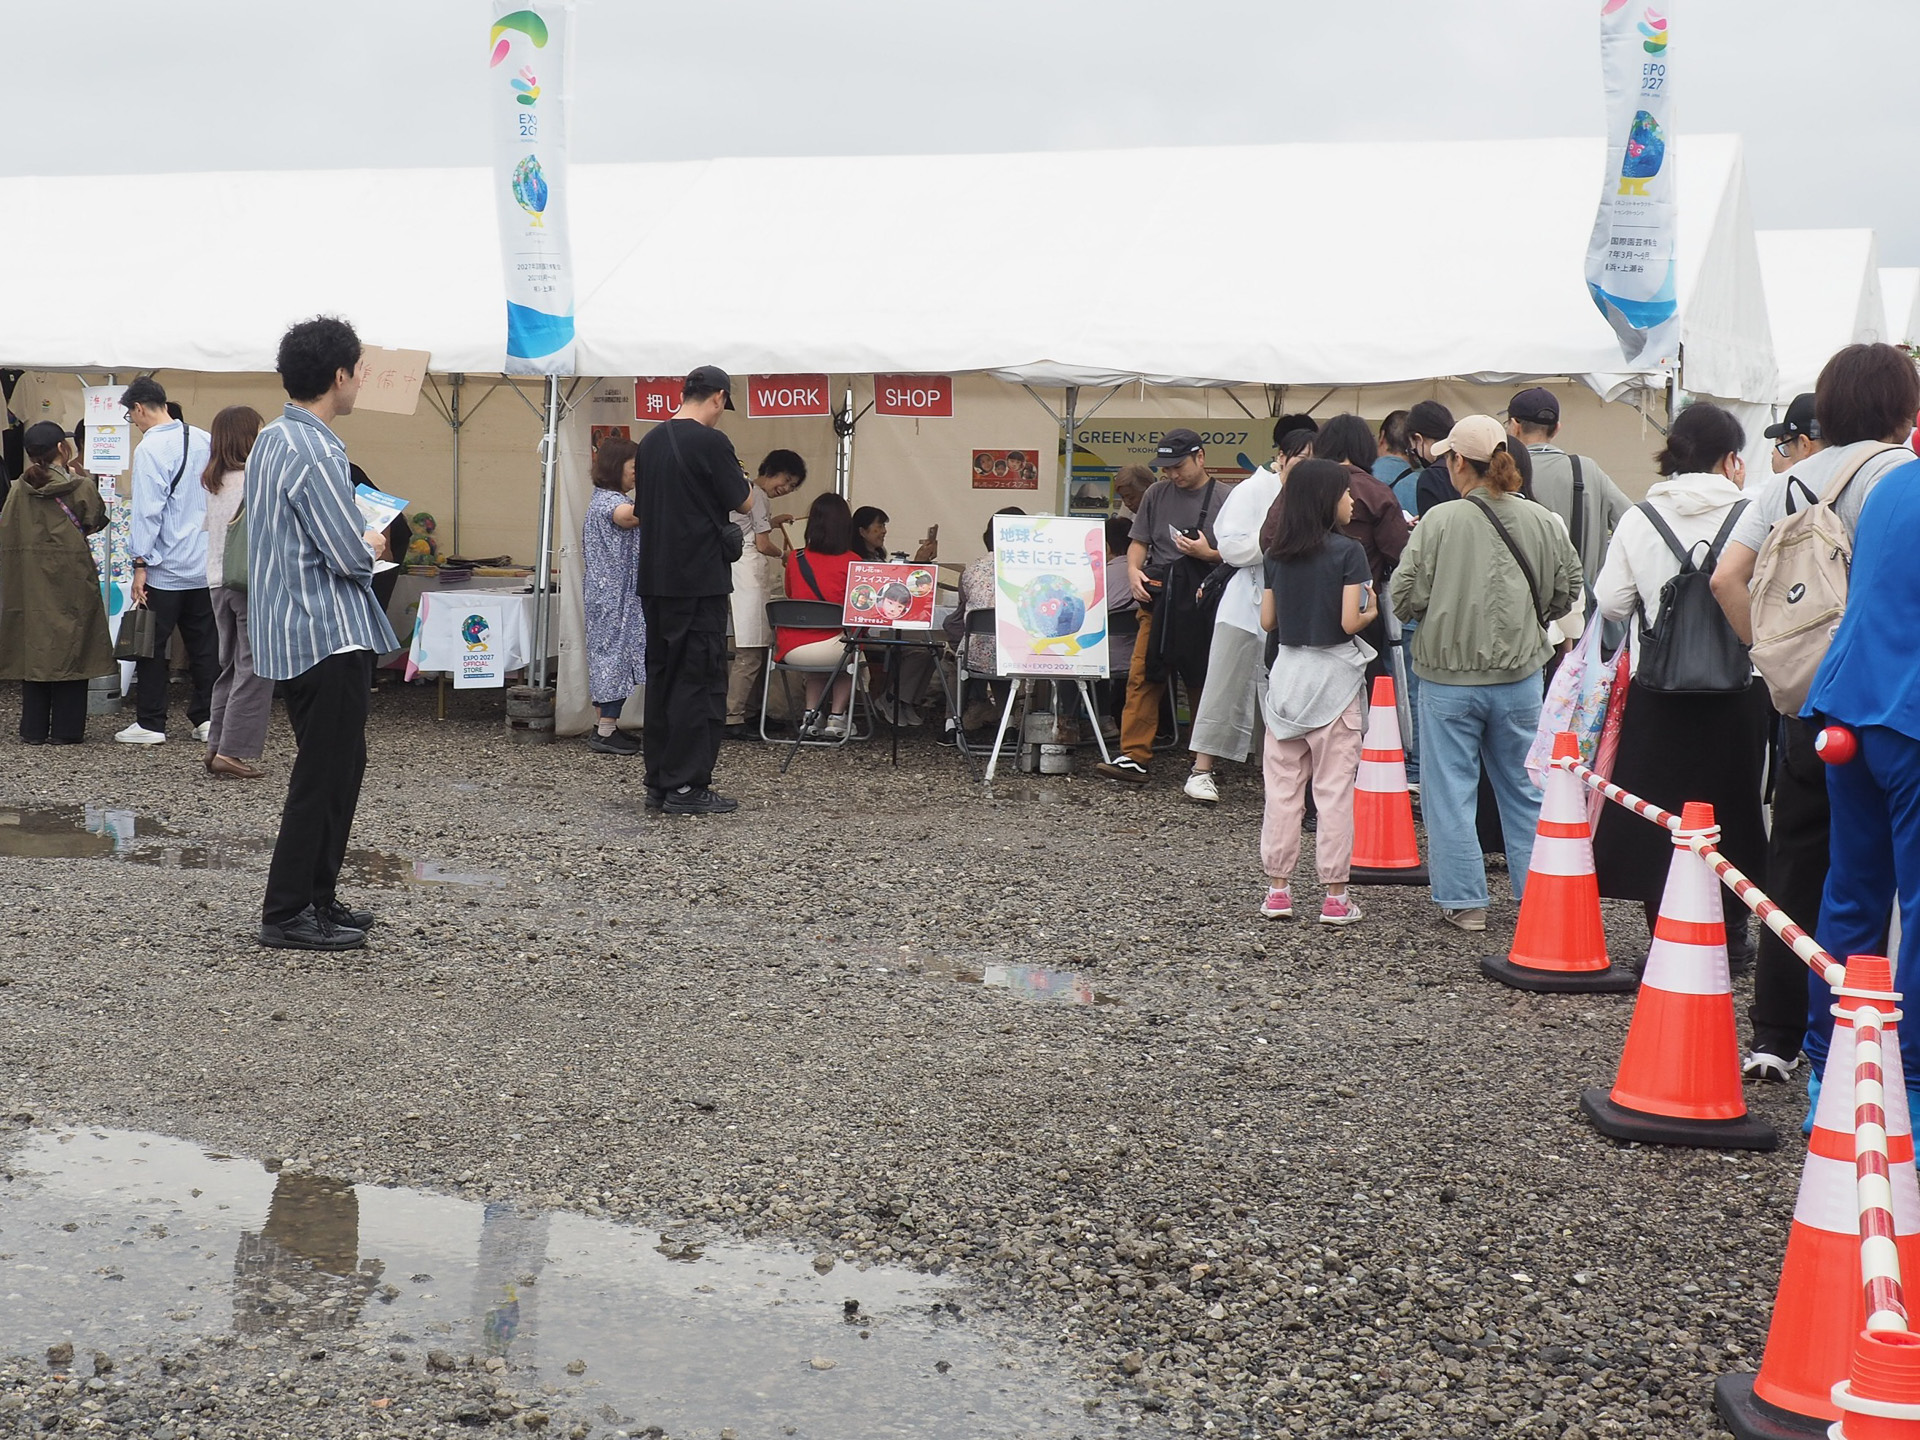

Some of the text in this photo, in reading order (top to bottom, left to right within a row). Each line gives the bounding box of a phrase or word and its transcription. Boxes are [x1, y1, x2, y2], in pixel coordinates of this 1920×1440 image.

[757, 387, 821, 409] WORK
[885, 388, 941, 408] SHOP
[1200, 432, 1249, 445] 2027
[854, 574, 904, 584] フェイスアート
